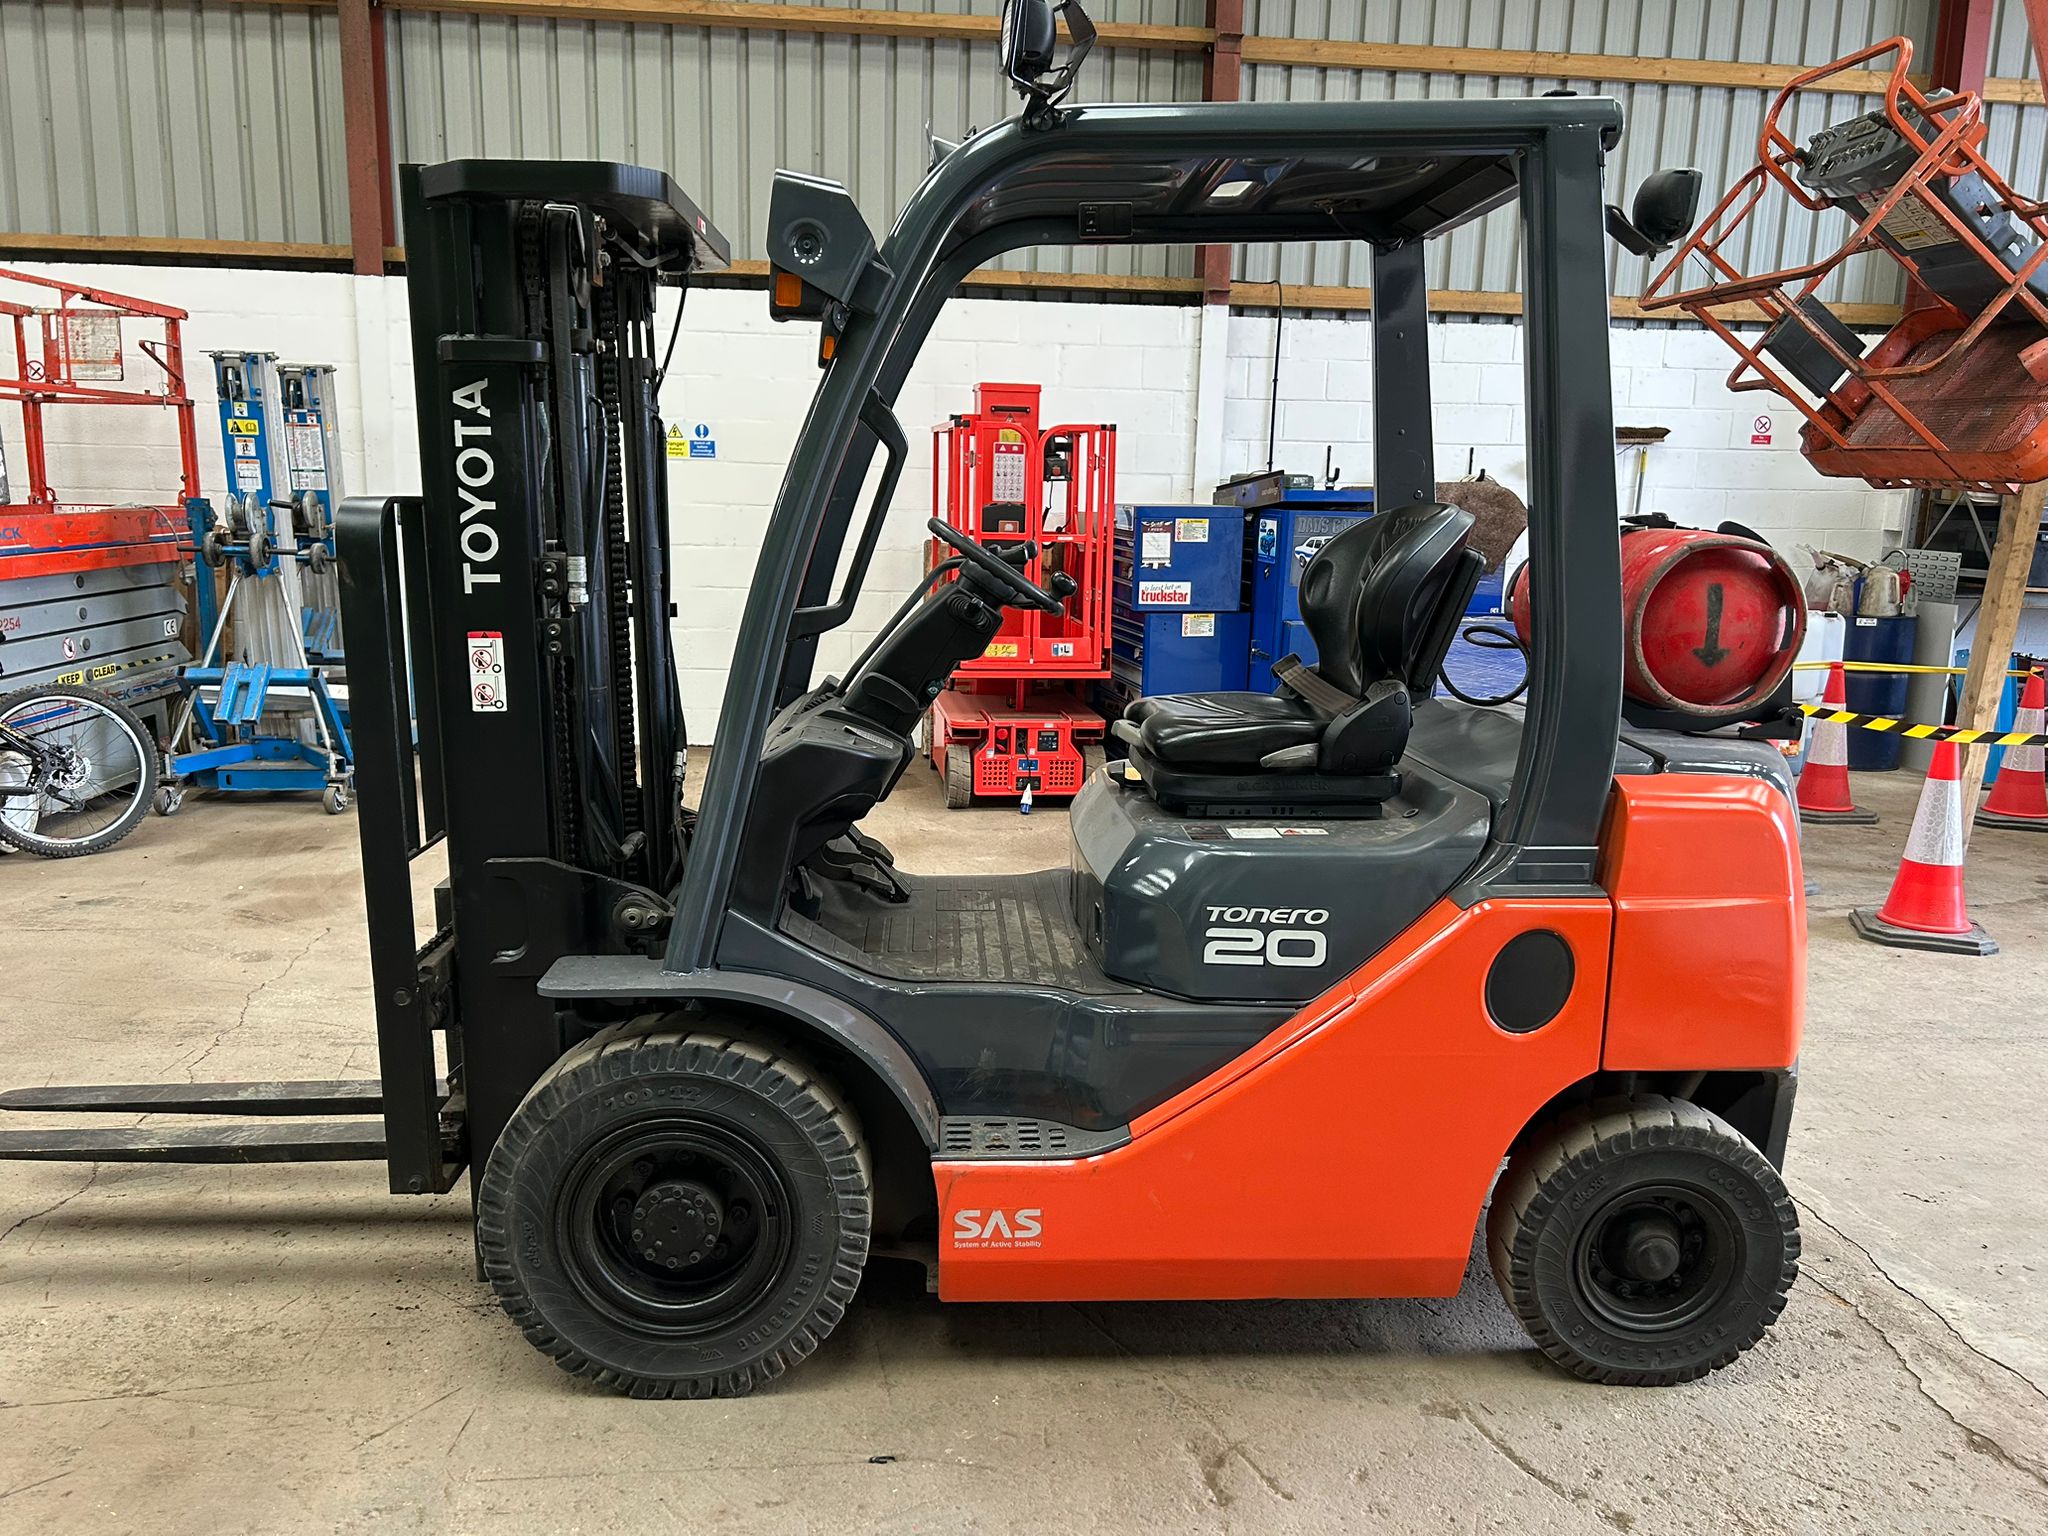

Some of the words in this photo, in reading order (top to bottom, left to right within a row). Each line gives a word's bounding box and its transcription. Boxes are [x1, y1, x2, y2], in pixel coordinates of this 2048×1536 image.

[453, 378, 500, 594] TOYOTA
[1141, 589, 1188, 602] truckstar
[61, 673, 80, 684] KEEP
[94, 665, 116, 678] CLEAR
[1203, 927, 1327, 967] 20
[954, 1209, 1042, 1238] SAS
[954, 1241, 979, 1249] System
[1014, 1240, 1042, 1248] Stability
[737, 1254, 821, 1351] TRELLEBORG
